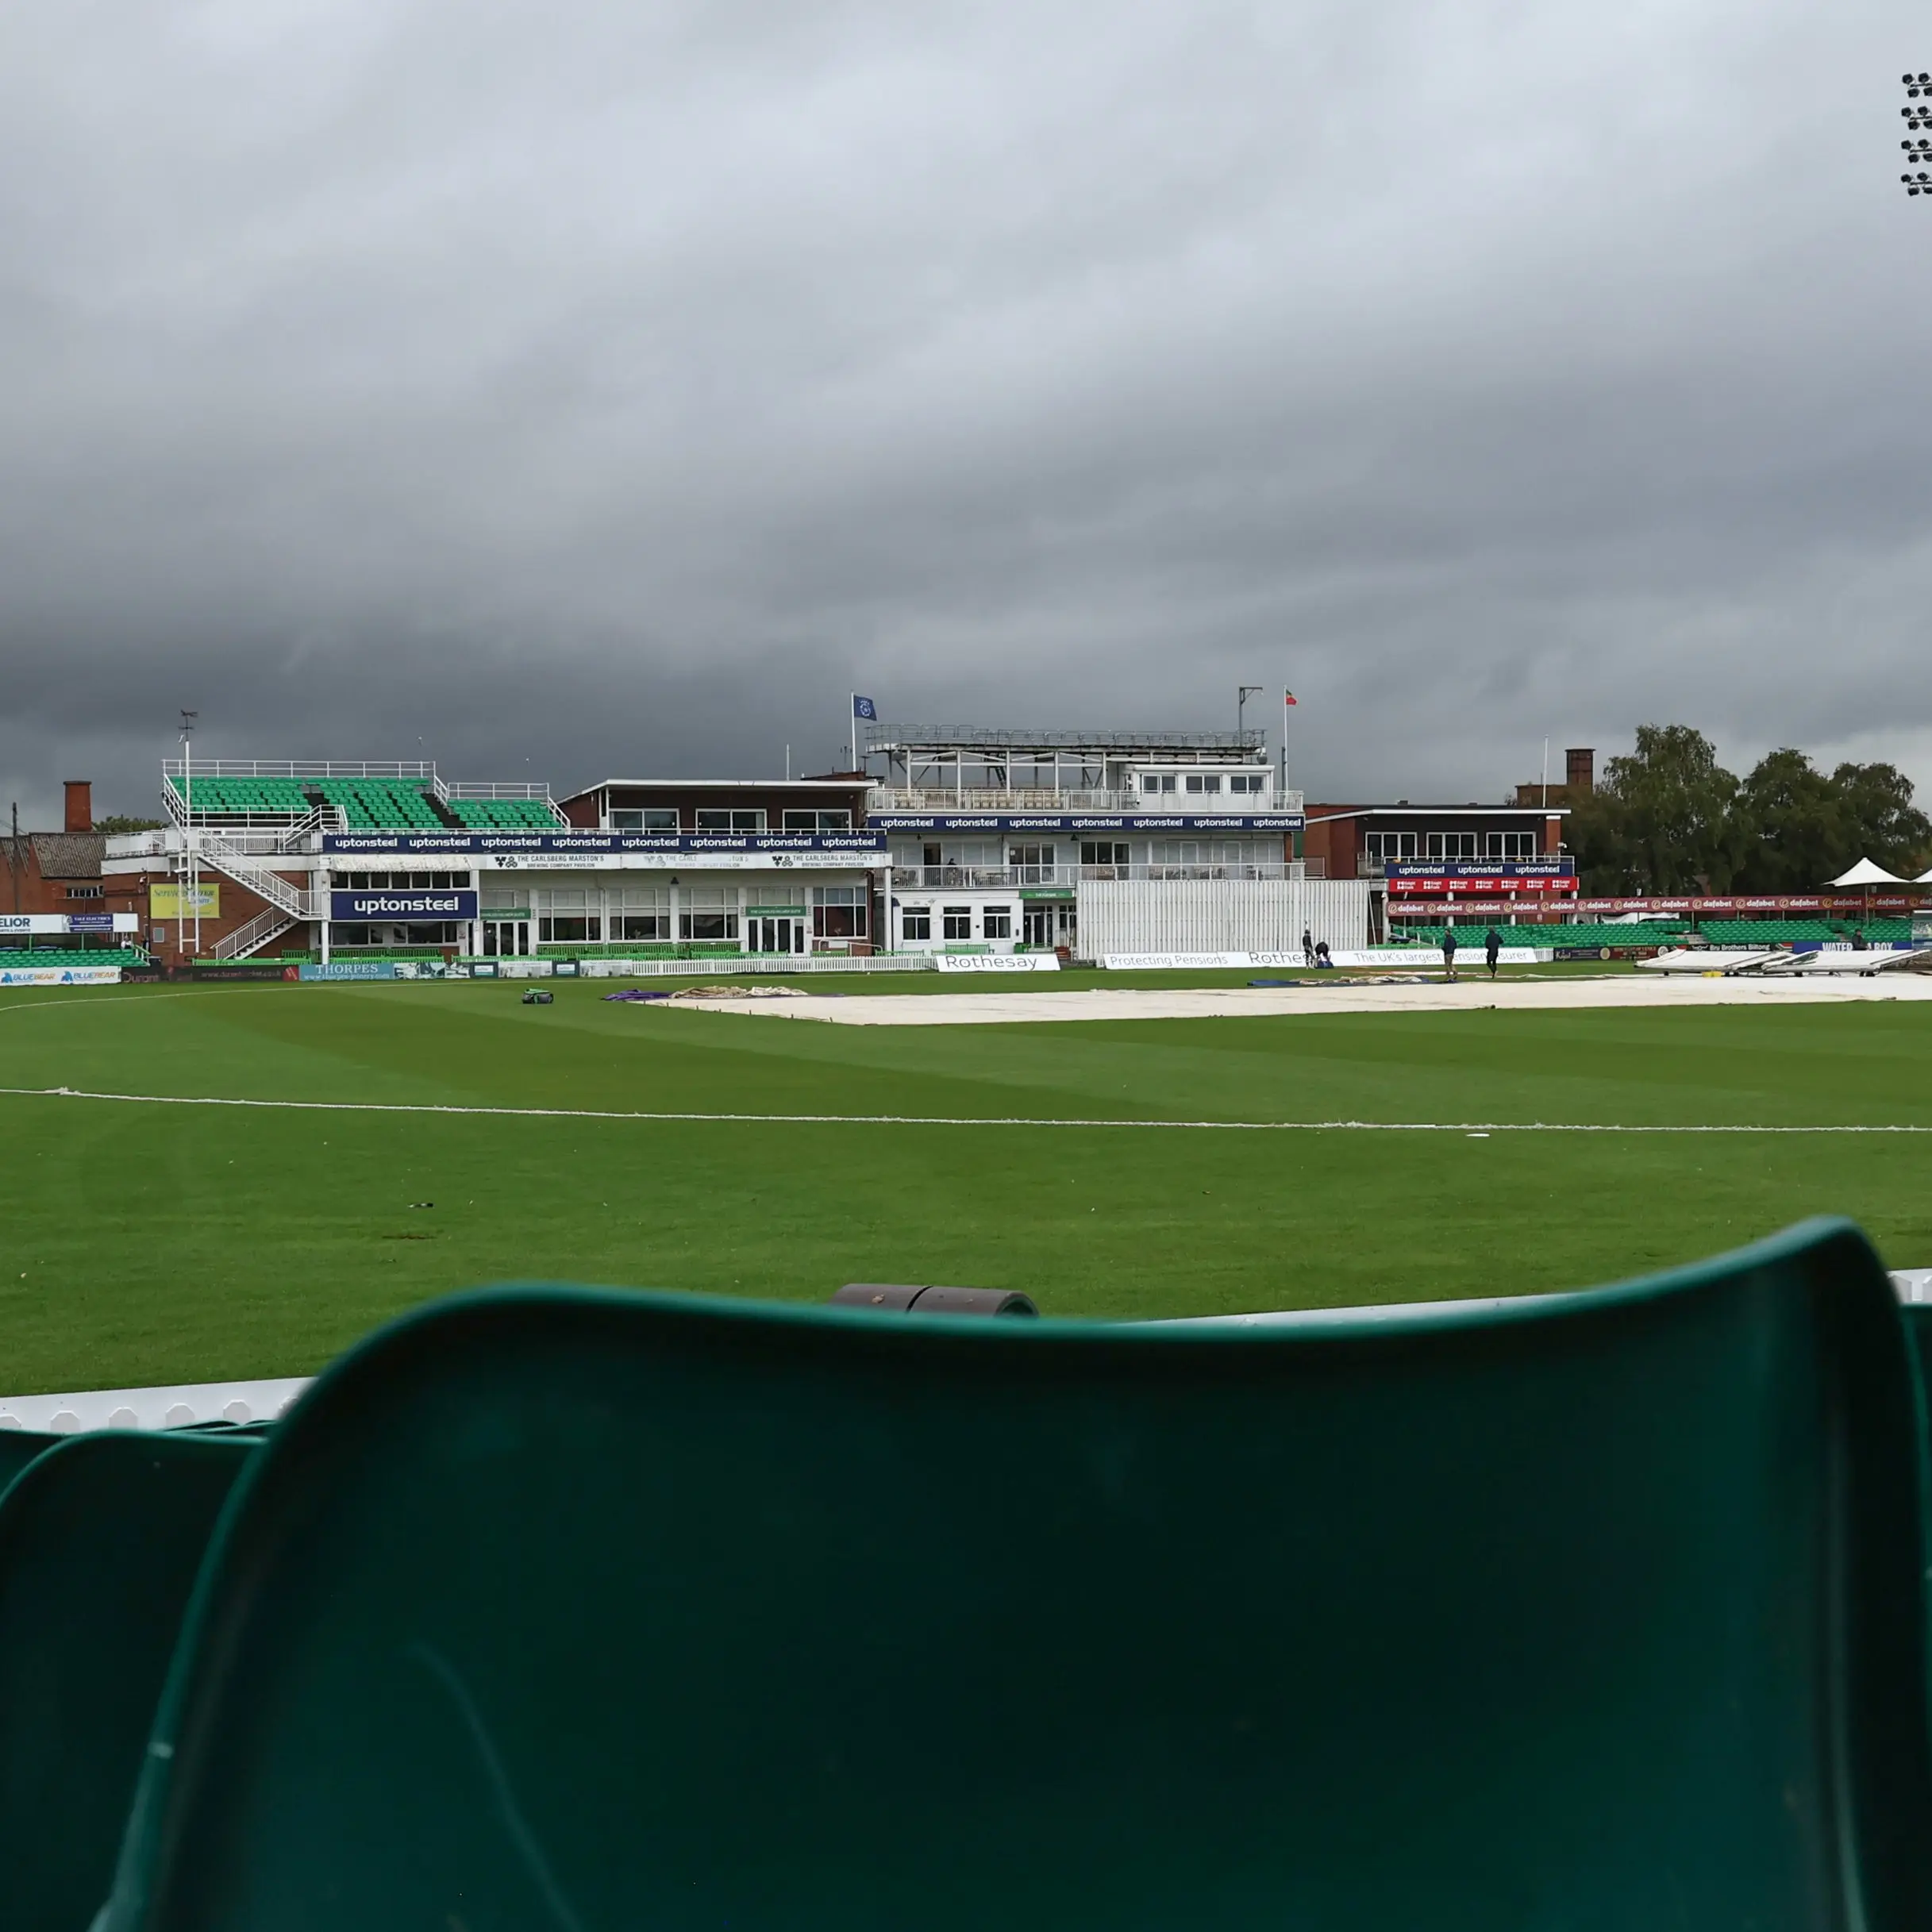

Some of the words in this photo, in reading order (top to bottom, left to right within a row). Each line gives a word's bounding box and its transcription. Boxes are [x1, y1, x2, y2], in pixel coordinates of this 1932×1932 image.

[881, 818, 933, 828] uptonsteel
[946, 818, 997, 828] uptonsteel
[1010, 818, 1060, 828] uptonsteel
[1072, 818, 1122, 828] uptonsteel
[1133, 818, 1183, 827] uptonsteel
[1195, 818, 1242, 827] uptonsteel
[336, 838, 397, 849] uptonsteel
[410, 837, 470, 848] uptonsteel
[482, 837, 541, 848] uptonsteel
[552, 838, 610, 848] uptonsteel
[622, 838, 679, 848] uptonsteel
[691, 838, 746, 848] uptonsteel
[757, 838, 811, 848] uptonsteel
[822, 838, 876, 848] uptonsteel
[1399, 866, 1445, 875] uptonsteel
[1458, 866, 1503, 875] uptonsteel
[355, 897, 458, 914] uptonsteel
[945, 955, 1037, 971] Rothesay
[1110, 956, 1172, 967] Protecting
[1175, 955, 1228, 965] Pensions
[1249, 952, 1331, 964] Rothe
[1354, 953, 1376, 962] The
[1378, 952, 1402, 962] UK's
[1404, 952, 1443, 964] largest
[315, 964, 379, 974] THORPES
